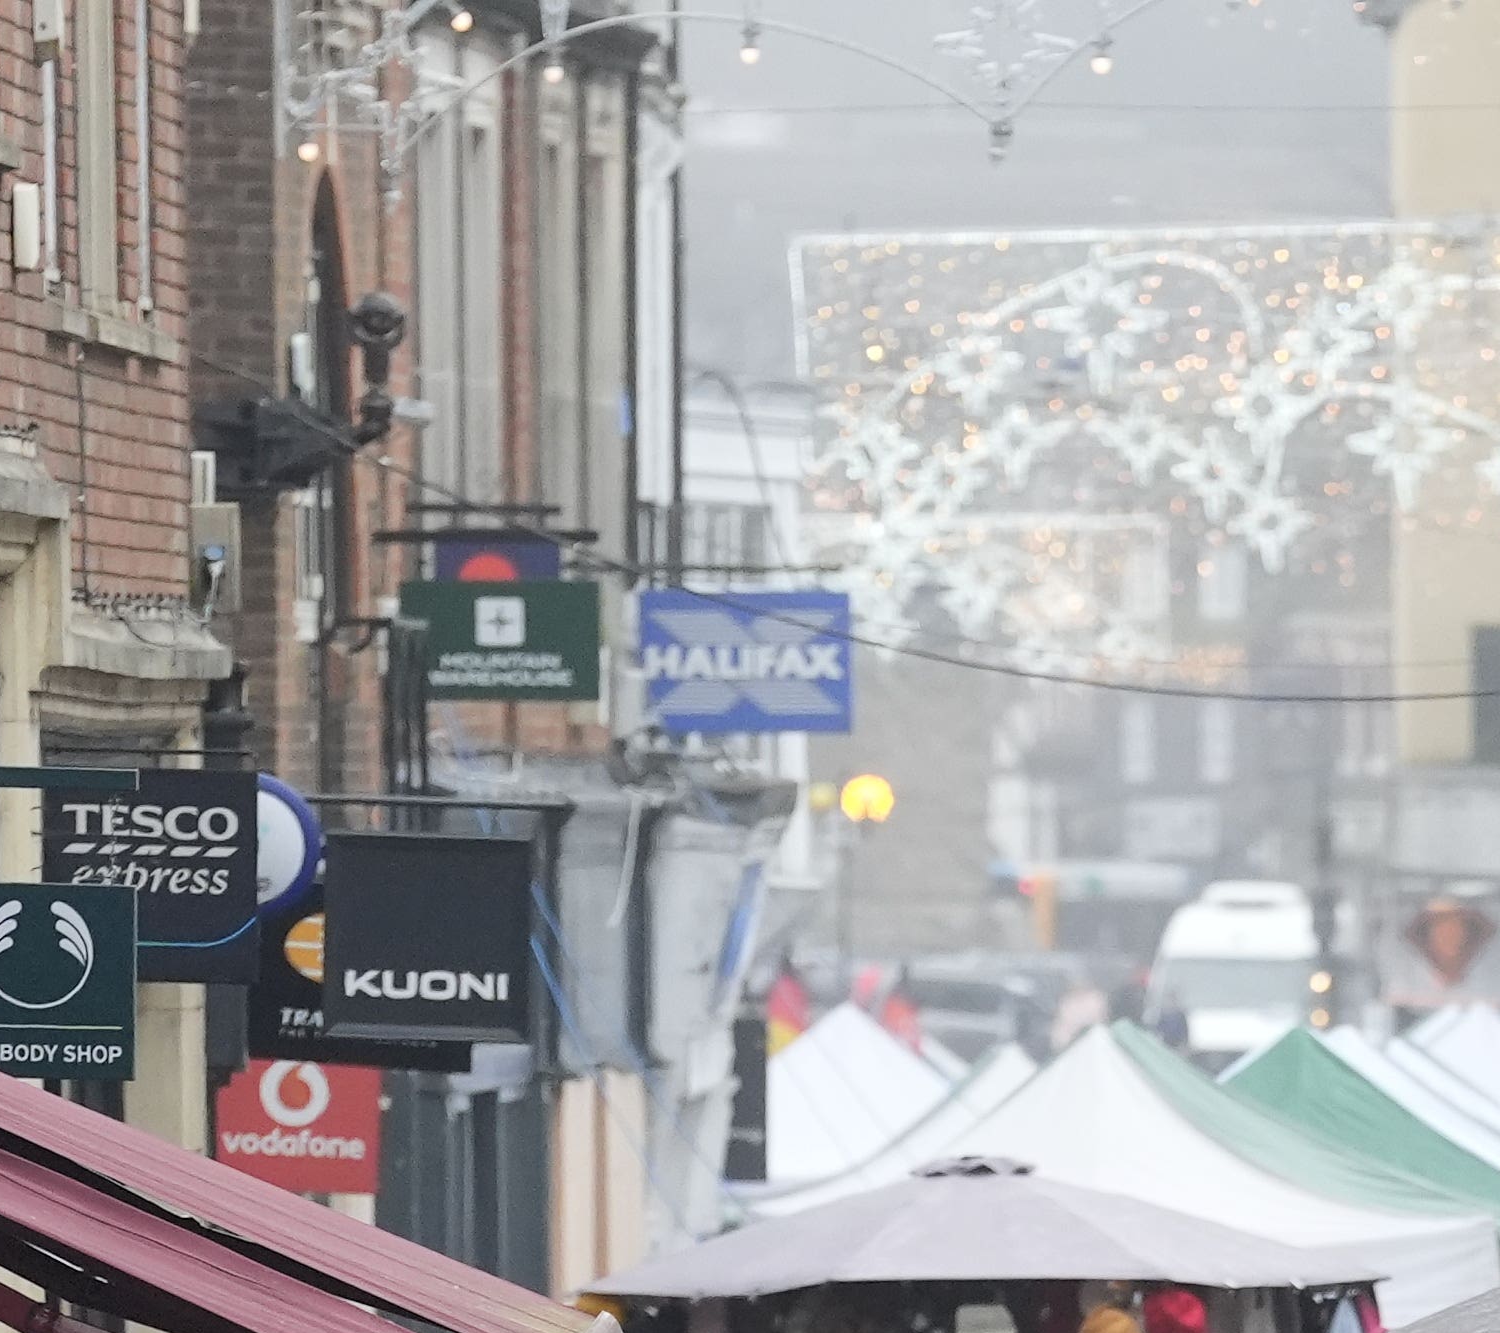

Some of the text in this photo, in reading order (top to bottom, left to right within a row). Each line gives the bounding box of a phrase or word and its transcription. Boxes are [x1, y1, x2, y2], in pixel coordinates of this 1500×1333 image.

[643, 643, 844, 681] HALIFAX
[61, 803, 239, 842] TESCO
[344, 969, 509, 1001] KUONI
[0, 1044, 58, 1062] BODY
[63, 1045, 122, 1064] SHOP
[222, 1127, 366, 1160] vodafone
